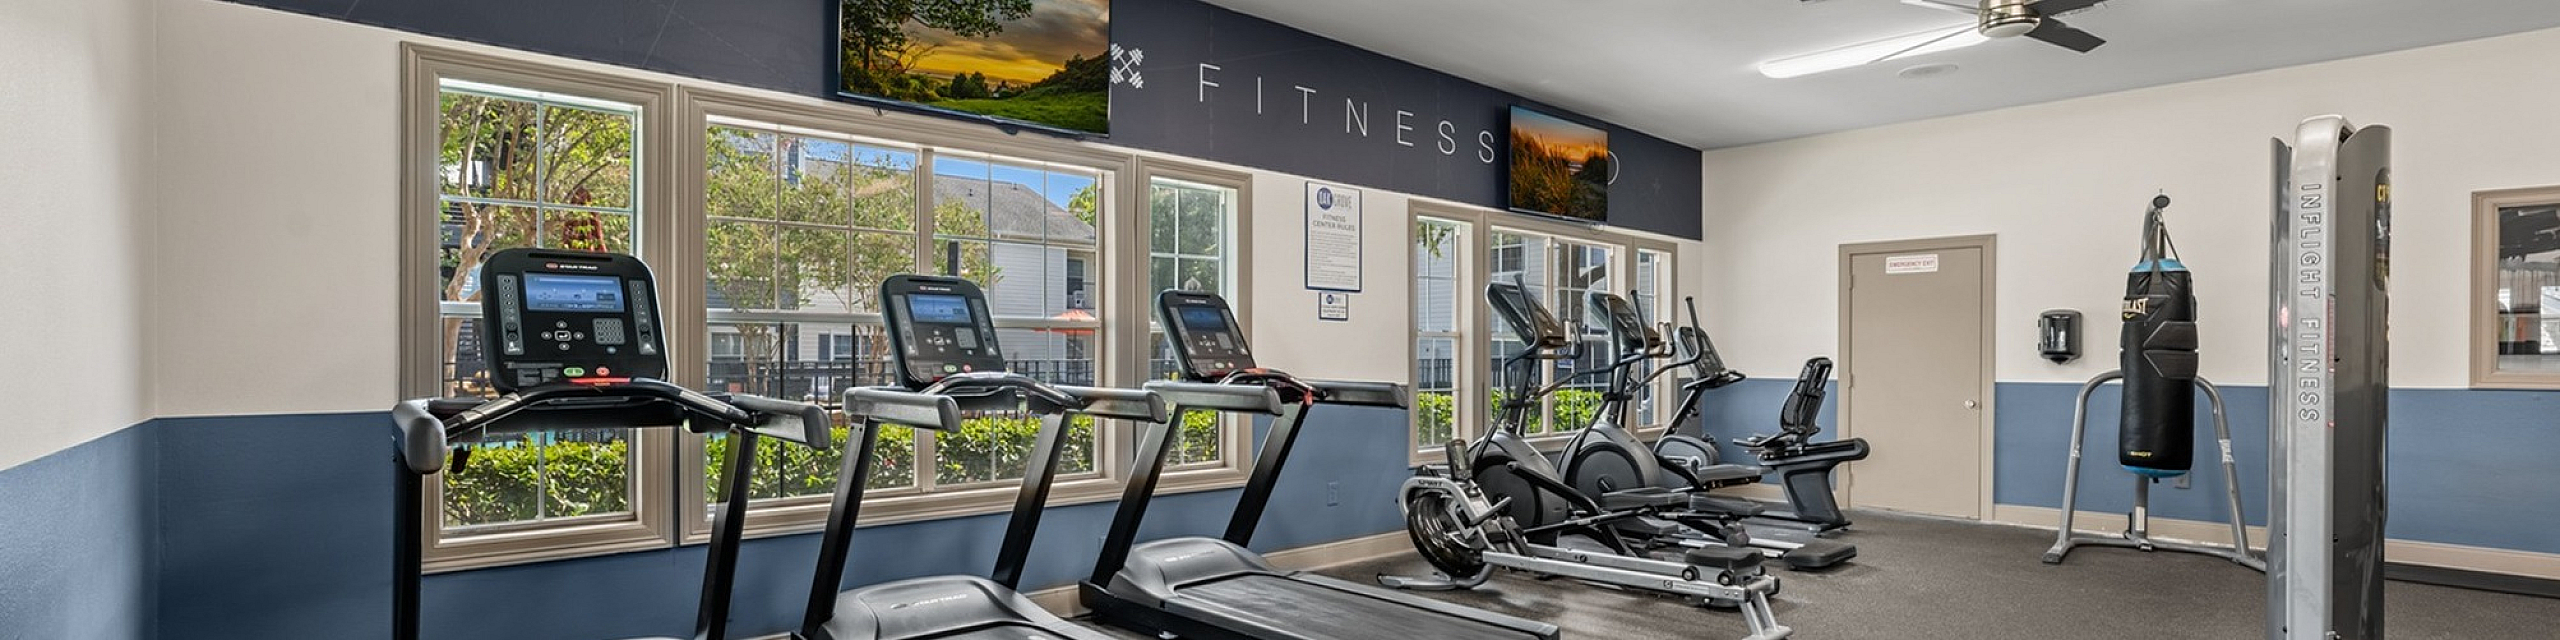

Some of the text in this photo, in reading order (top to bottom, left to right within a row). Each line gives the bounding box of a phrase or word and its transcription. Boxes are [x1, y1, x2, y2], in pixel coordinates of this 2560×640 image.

[1199, 63, 1496, 164] FITNESS
[1312, 220, 1336, 229] CENTER
[1321, 213, 1346, 223] FITNESS
[2299, 182, 2322, 422] INFLIGHT FITNESS
